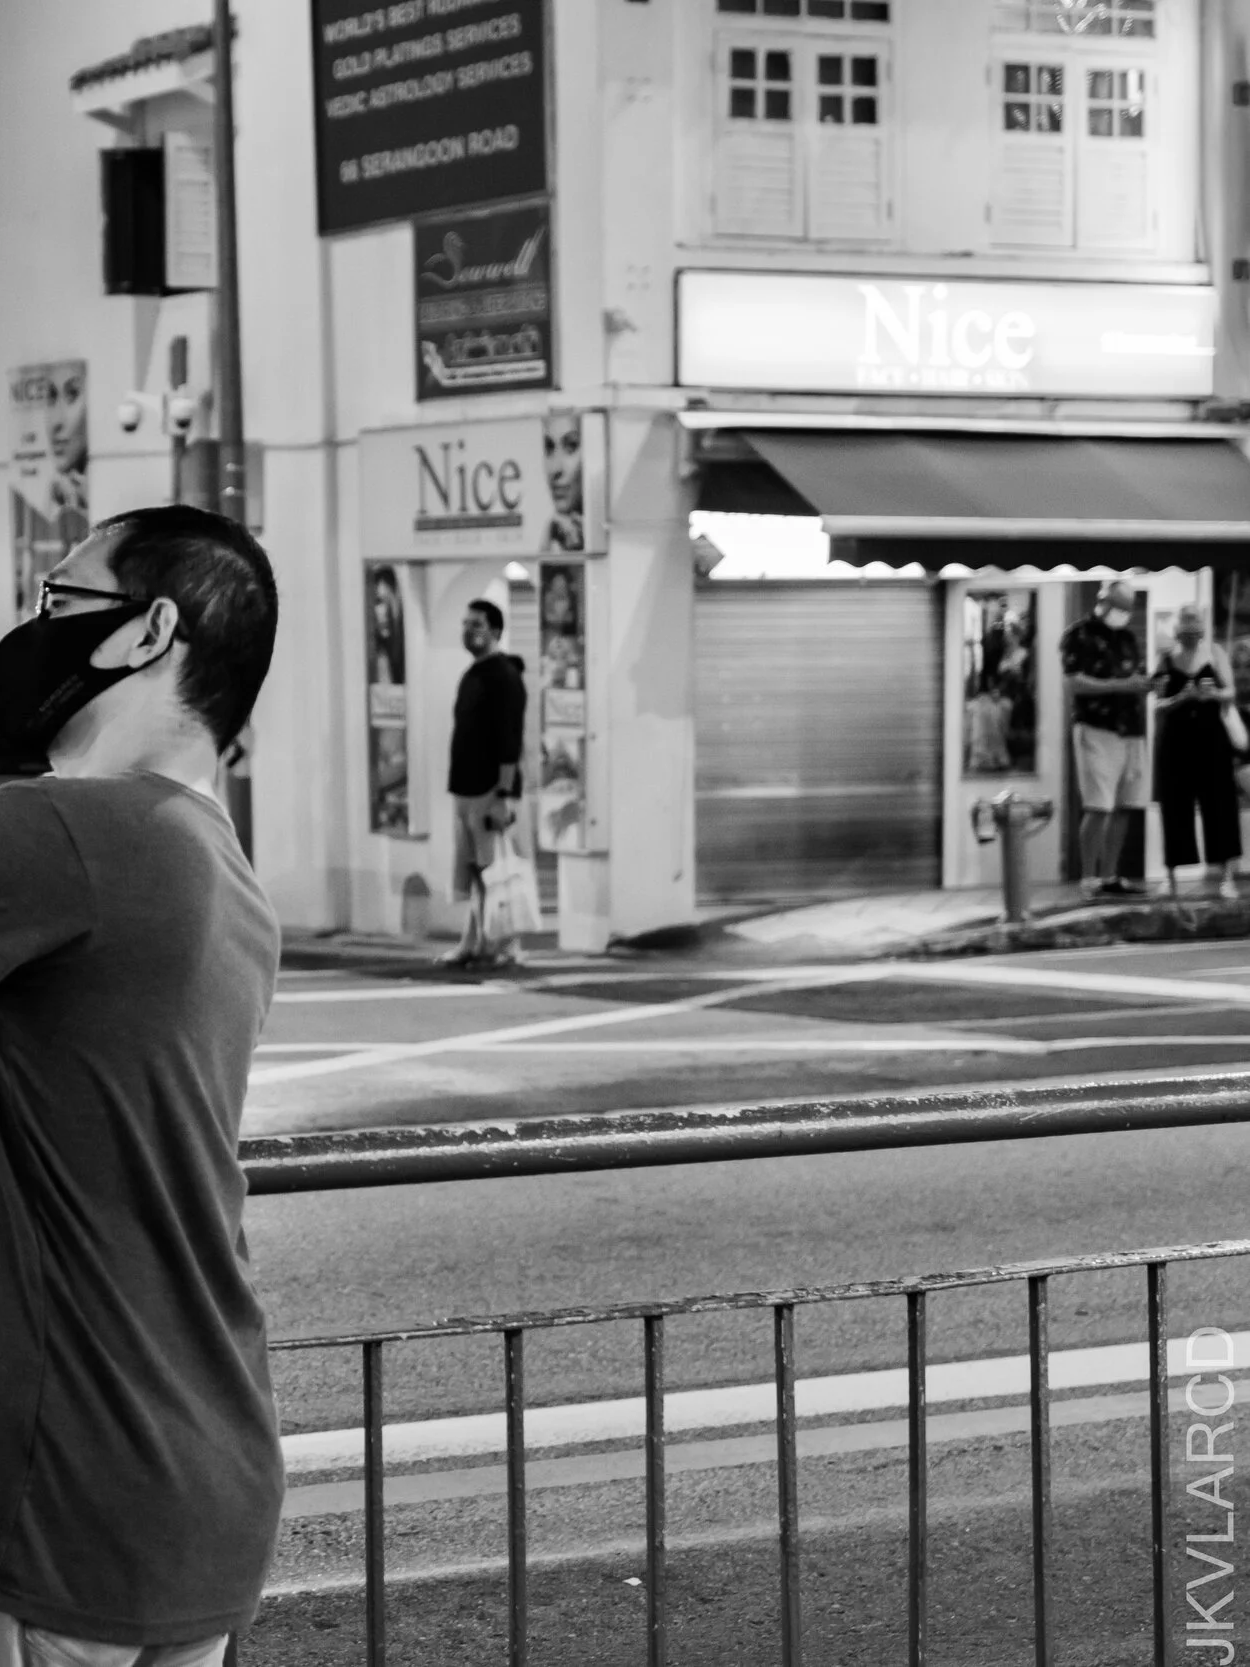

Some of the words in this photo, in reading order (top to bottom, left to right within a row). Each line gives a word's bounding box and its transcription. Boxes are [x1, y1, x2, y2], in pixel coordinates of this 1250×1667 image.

[332, 51, 371, 80] GOLD
[446, 12, 522, 50] SERVICES
[325, 90, 367, 119] VEDIC
[370, 70, 454, 108] ASTROLOGY
[456, 50, 533, 89] SERVICES
[361, 135, 465, 180] SERANGOON
[468, 124, 519, 155] ROAD
[857, 283, 1037, 370] Nice
[414, 439, 521, 513] Nice
